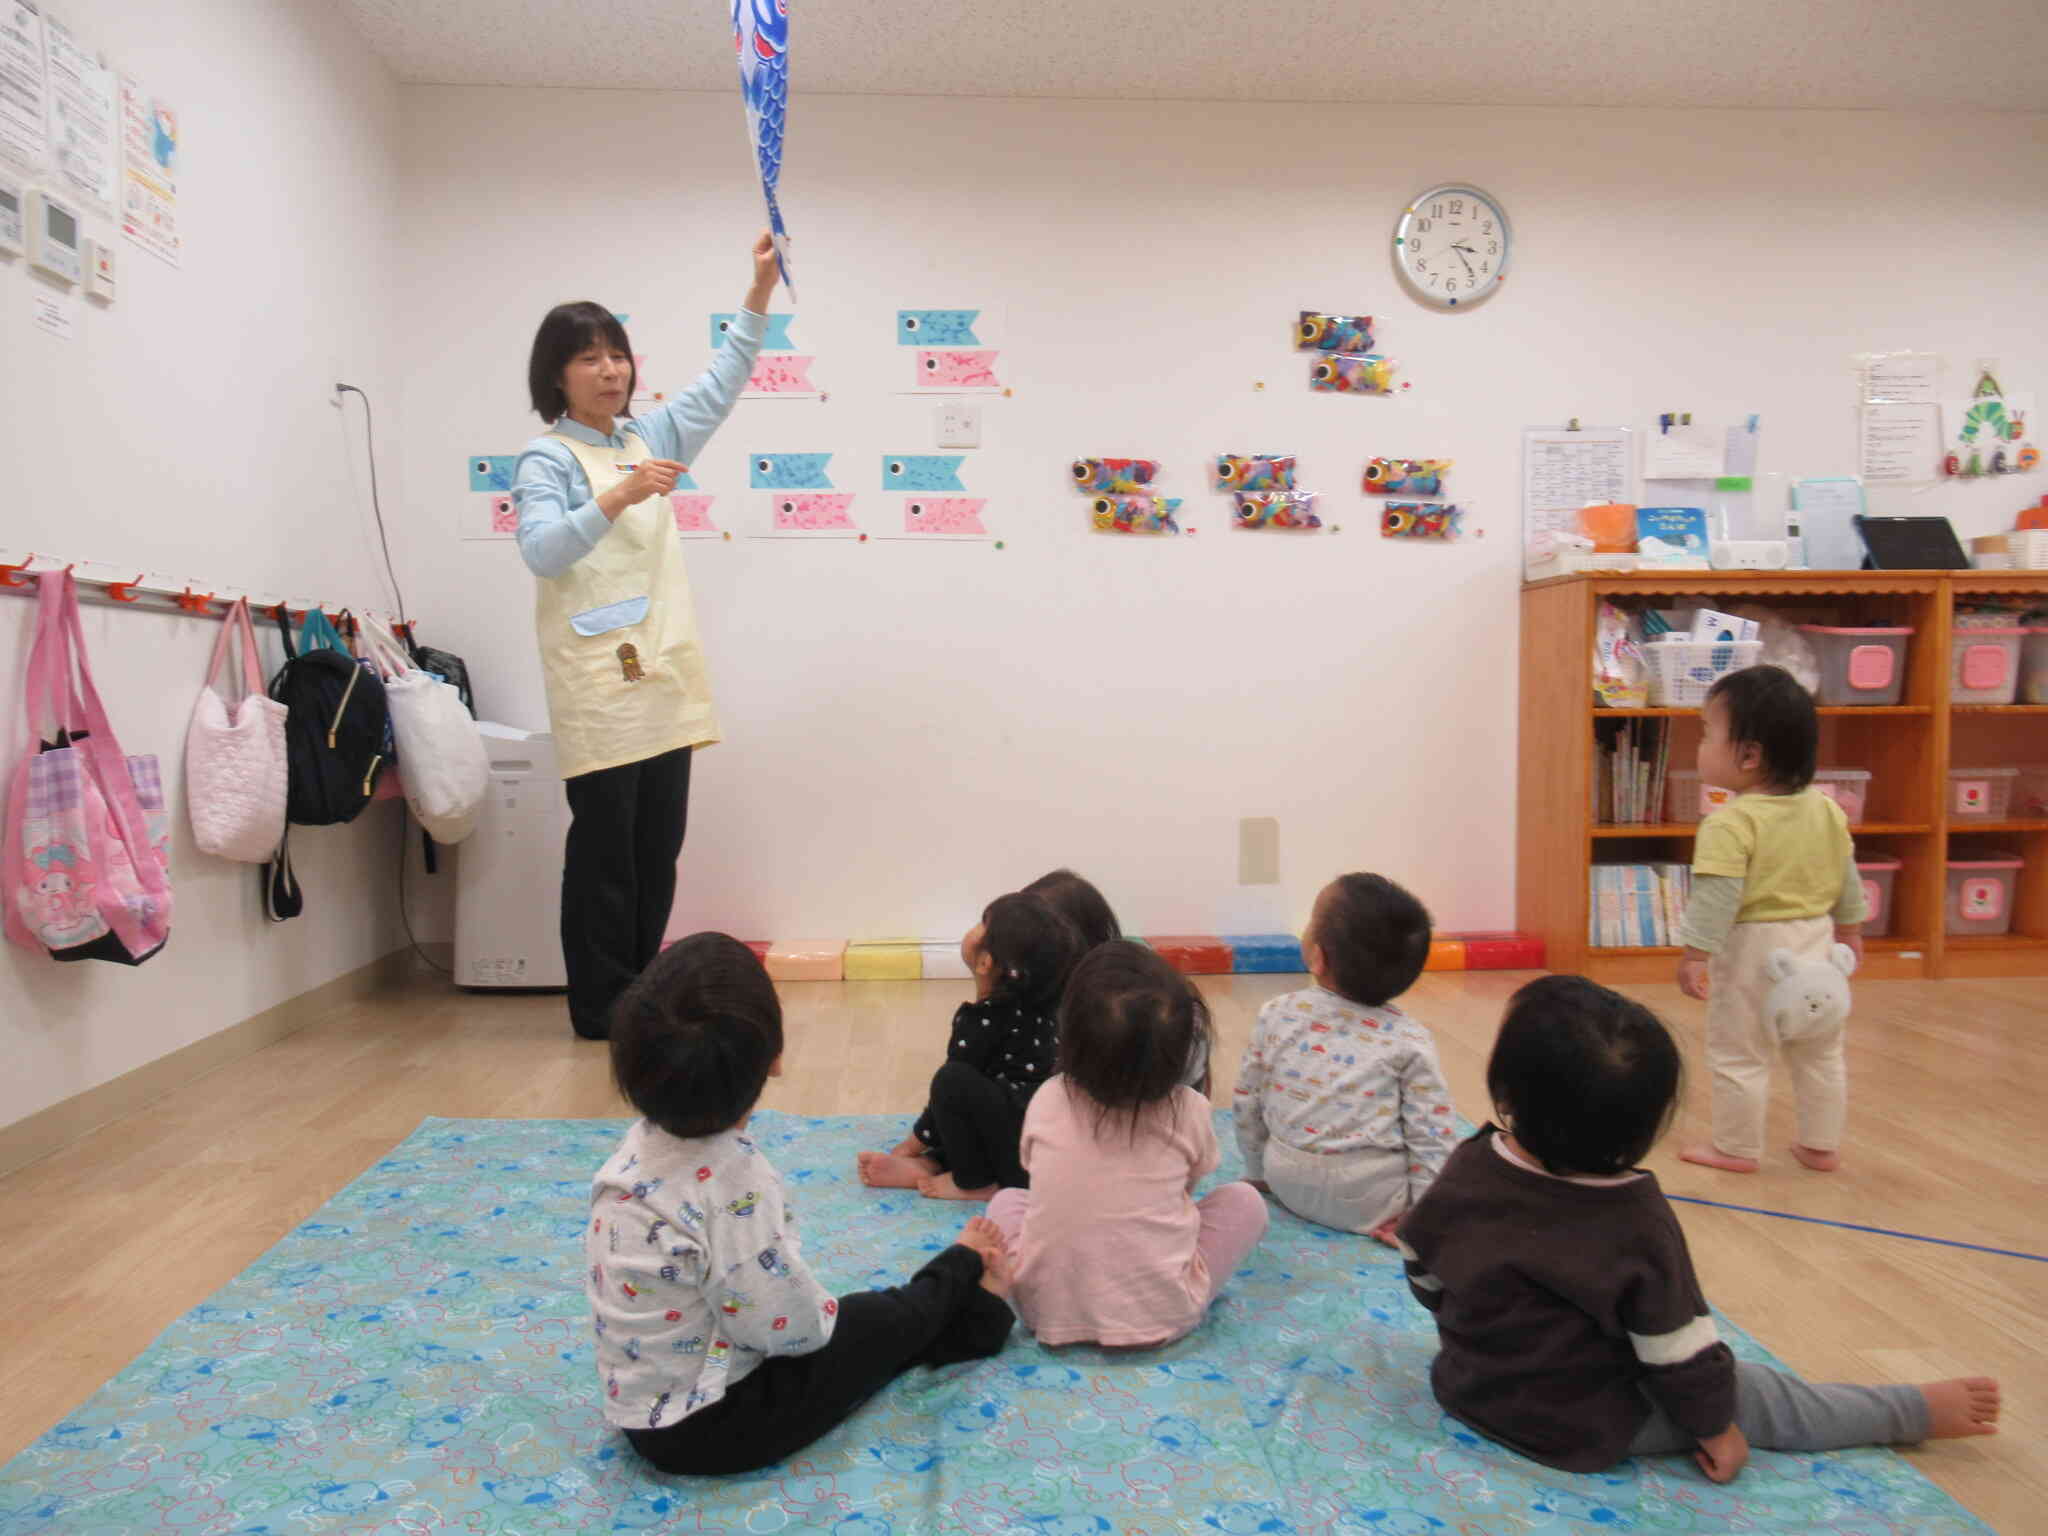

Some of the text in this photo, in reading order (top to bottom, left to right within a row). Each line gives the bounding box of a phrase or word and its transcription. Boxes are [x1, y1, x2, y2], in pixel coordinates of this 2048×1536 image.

[1431, 204, 1443, 219] 11
[1448, 200, 1463, 214] 12
[1471, 205, 1478, 220] 1
[1417, 218, 1431, 232] 10
[1481, 220, 1492, 235] 2
[1410, 238, 1421, 253] 9
[1487, 240, 1498, 255] 3
[1416, 258, 1426, 272] 8
[1480, 260, 1489, 273] 4
[1429, 272, 1440, 286] 7
[1446, 278, 1457, 292] 6
[1465, 273, 1475, 288] 5
